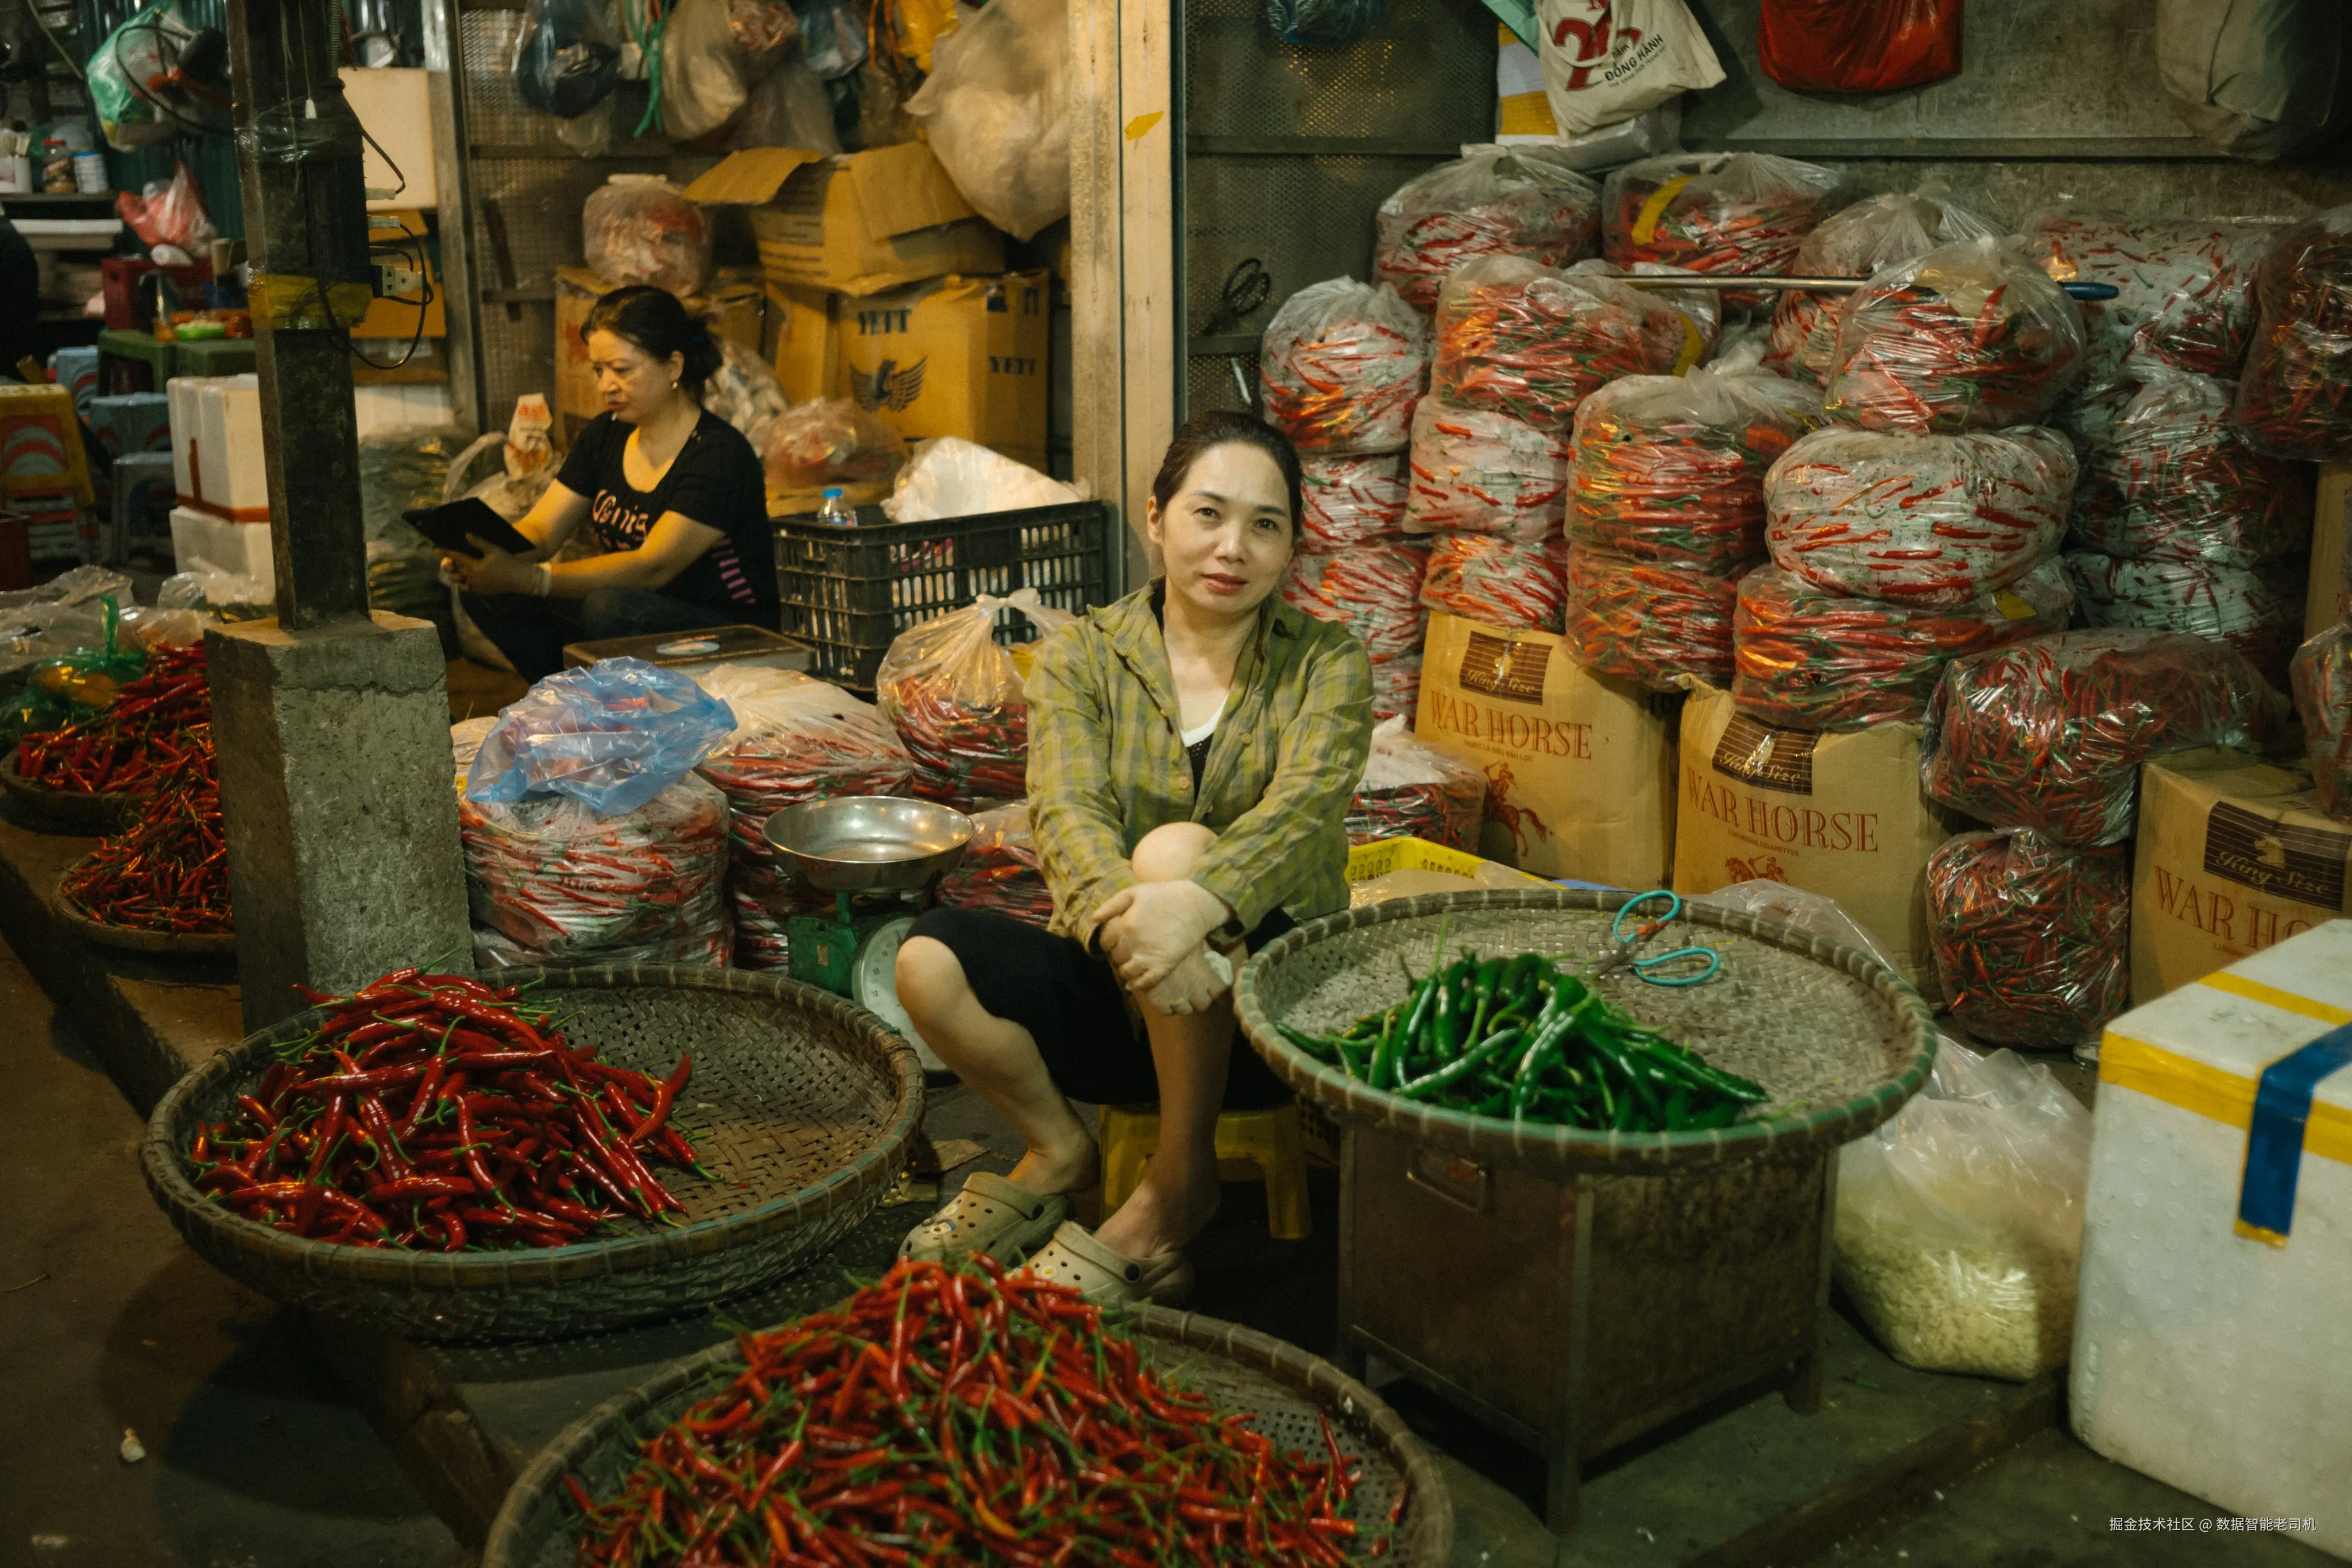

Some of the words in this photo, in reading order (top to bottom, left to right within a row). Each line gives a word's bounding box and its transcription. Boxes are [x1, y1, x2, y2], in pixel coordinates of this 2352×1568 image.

[1637, 34, 1664, 61] HÀNH
[1508, 677, 1535, 694] Size
[1430, 688, 1480, 738] WAR
[1486, 707, 1592, 761] HORSE
[1767, 764, 1801, 783] Size
[1686, 765, 1740, 827] WAR
[1745, 796, 1878, 854] HORSE
[2216, 850, 2273, 885] King
[2285, 870, 2330, 895] Size
[2154, 864, 2235, 941] WAR
